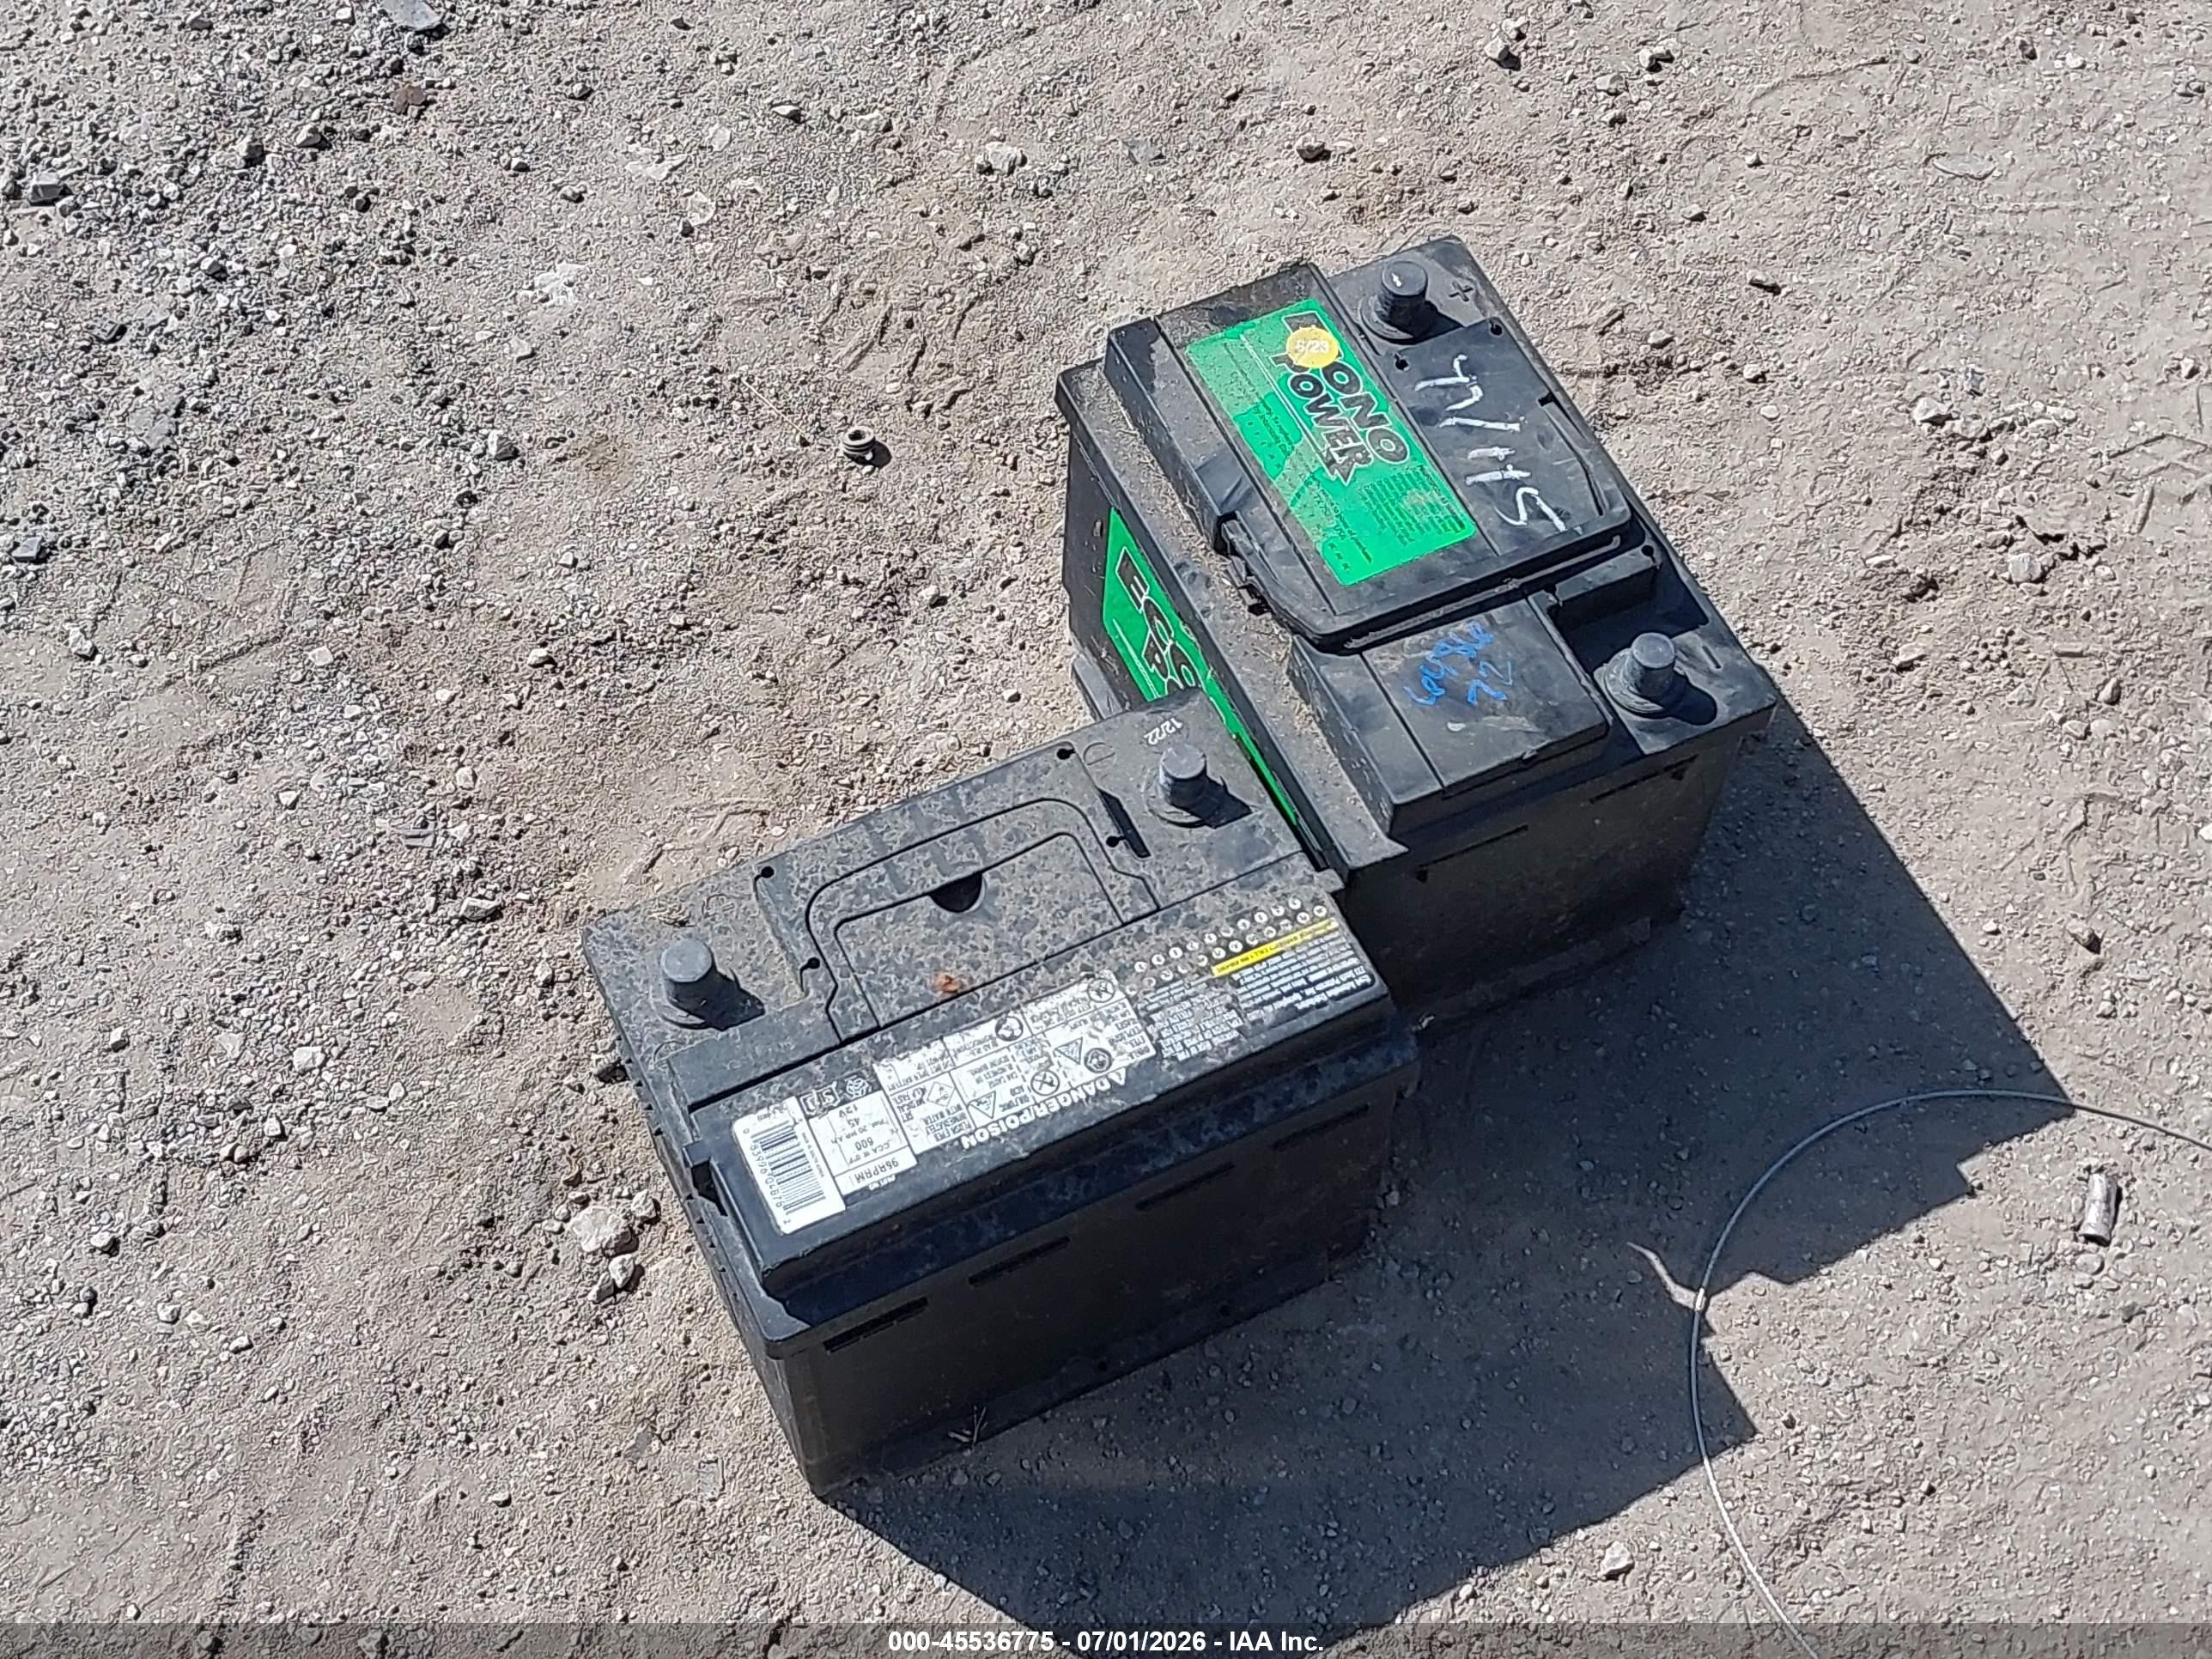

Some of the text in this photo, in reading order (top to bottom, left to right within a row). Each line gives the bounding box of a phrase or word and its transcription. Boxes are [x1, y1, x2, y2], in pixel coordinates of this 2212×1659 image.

[1143, 717, 1182, 744] 12/22
[837, 1103, 858, 1117] 12V
[960, 1076, 1109, 1148] DANGER/POISON
[847, 1116, 860, 1127] 45
[854, 1137, 874, 1151] 600
